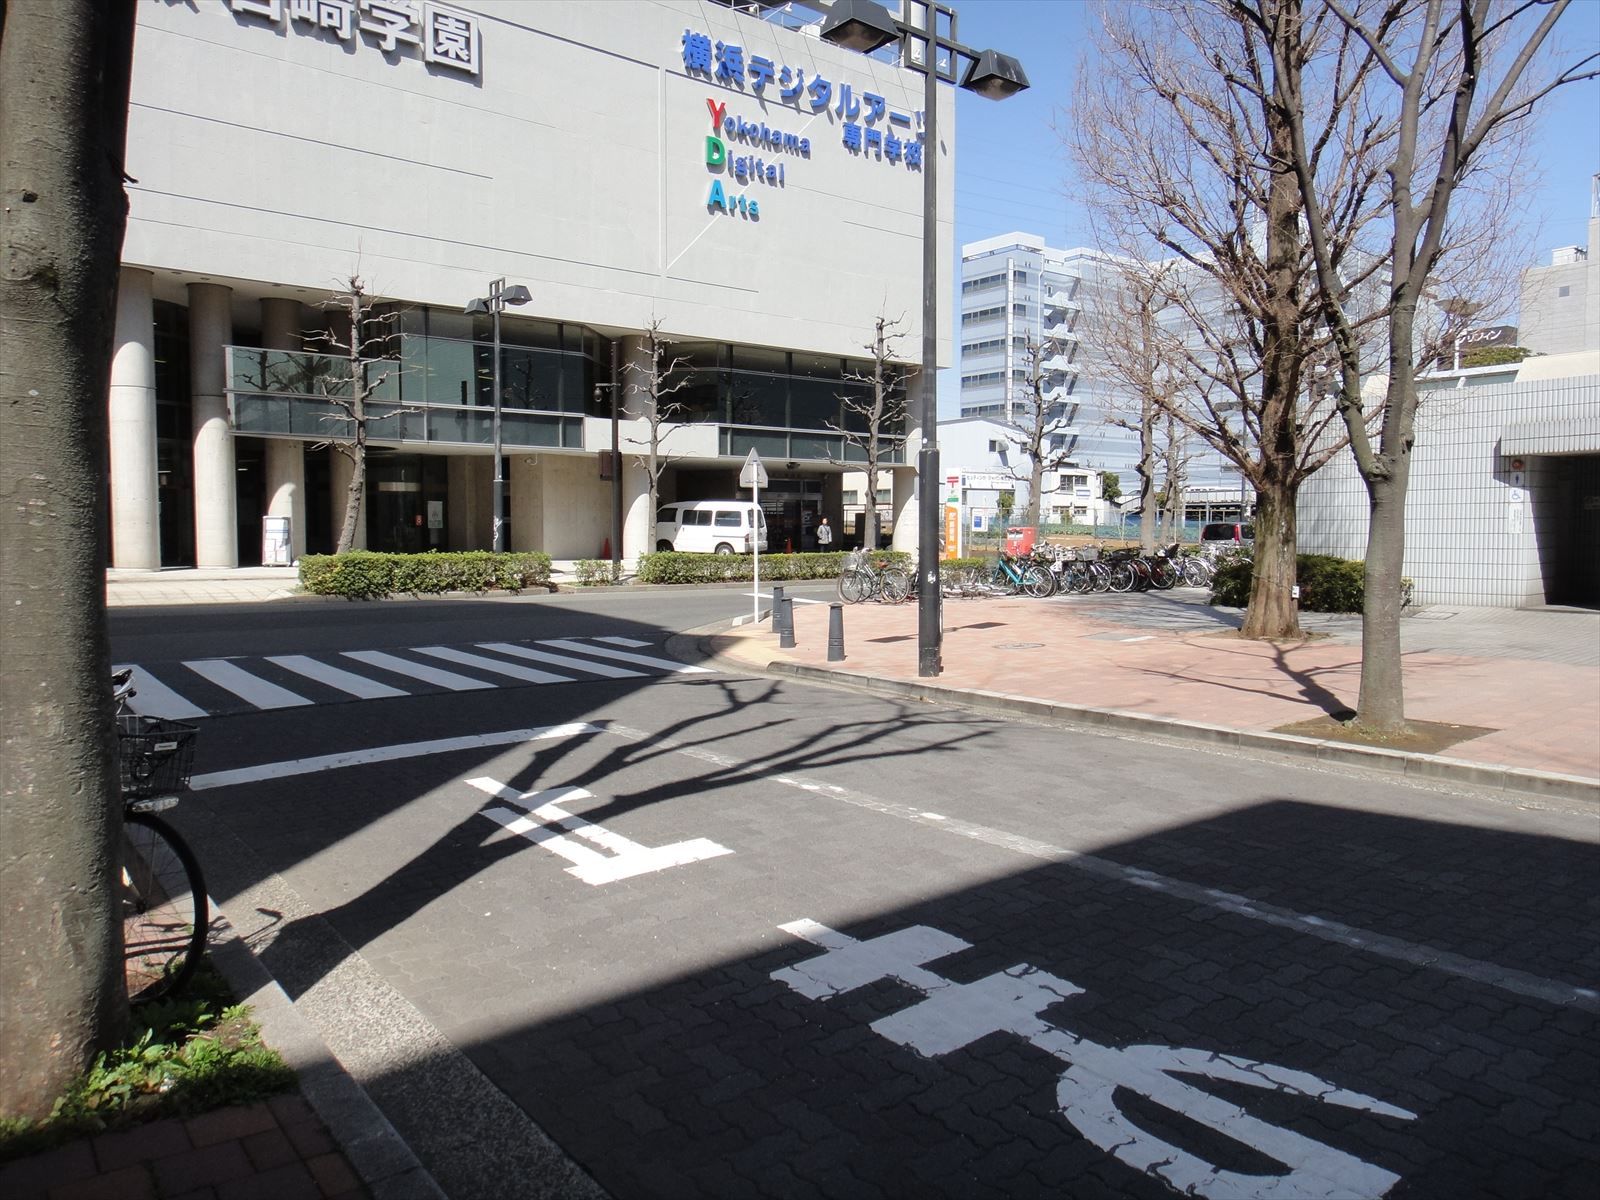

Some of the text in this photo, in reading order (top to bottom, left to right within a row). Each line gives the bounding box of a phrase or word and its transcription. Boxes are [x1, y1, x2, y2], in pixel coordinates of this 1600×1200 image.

[706, 98, 811, 156] Yokohama
[842, 122, 922, 170] 専門学校
[705, 136, 785, 184] Digital
[707, 180, 760, 215] Arts
